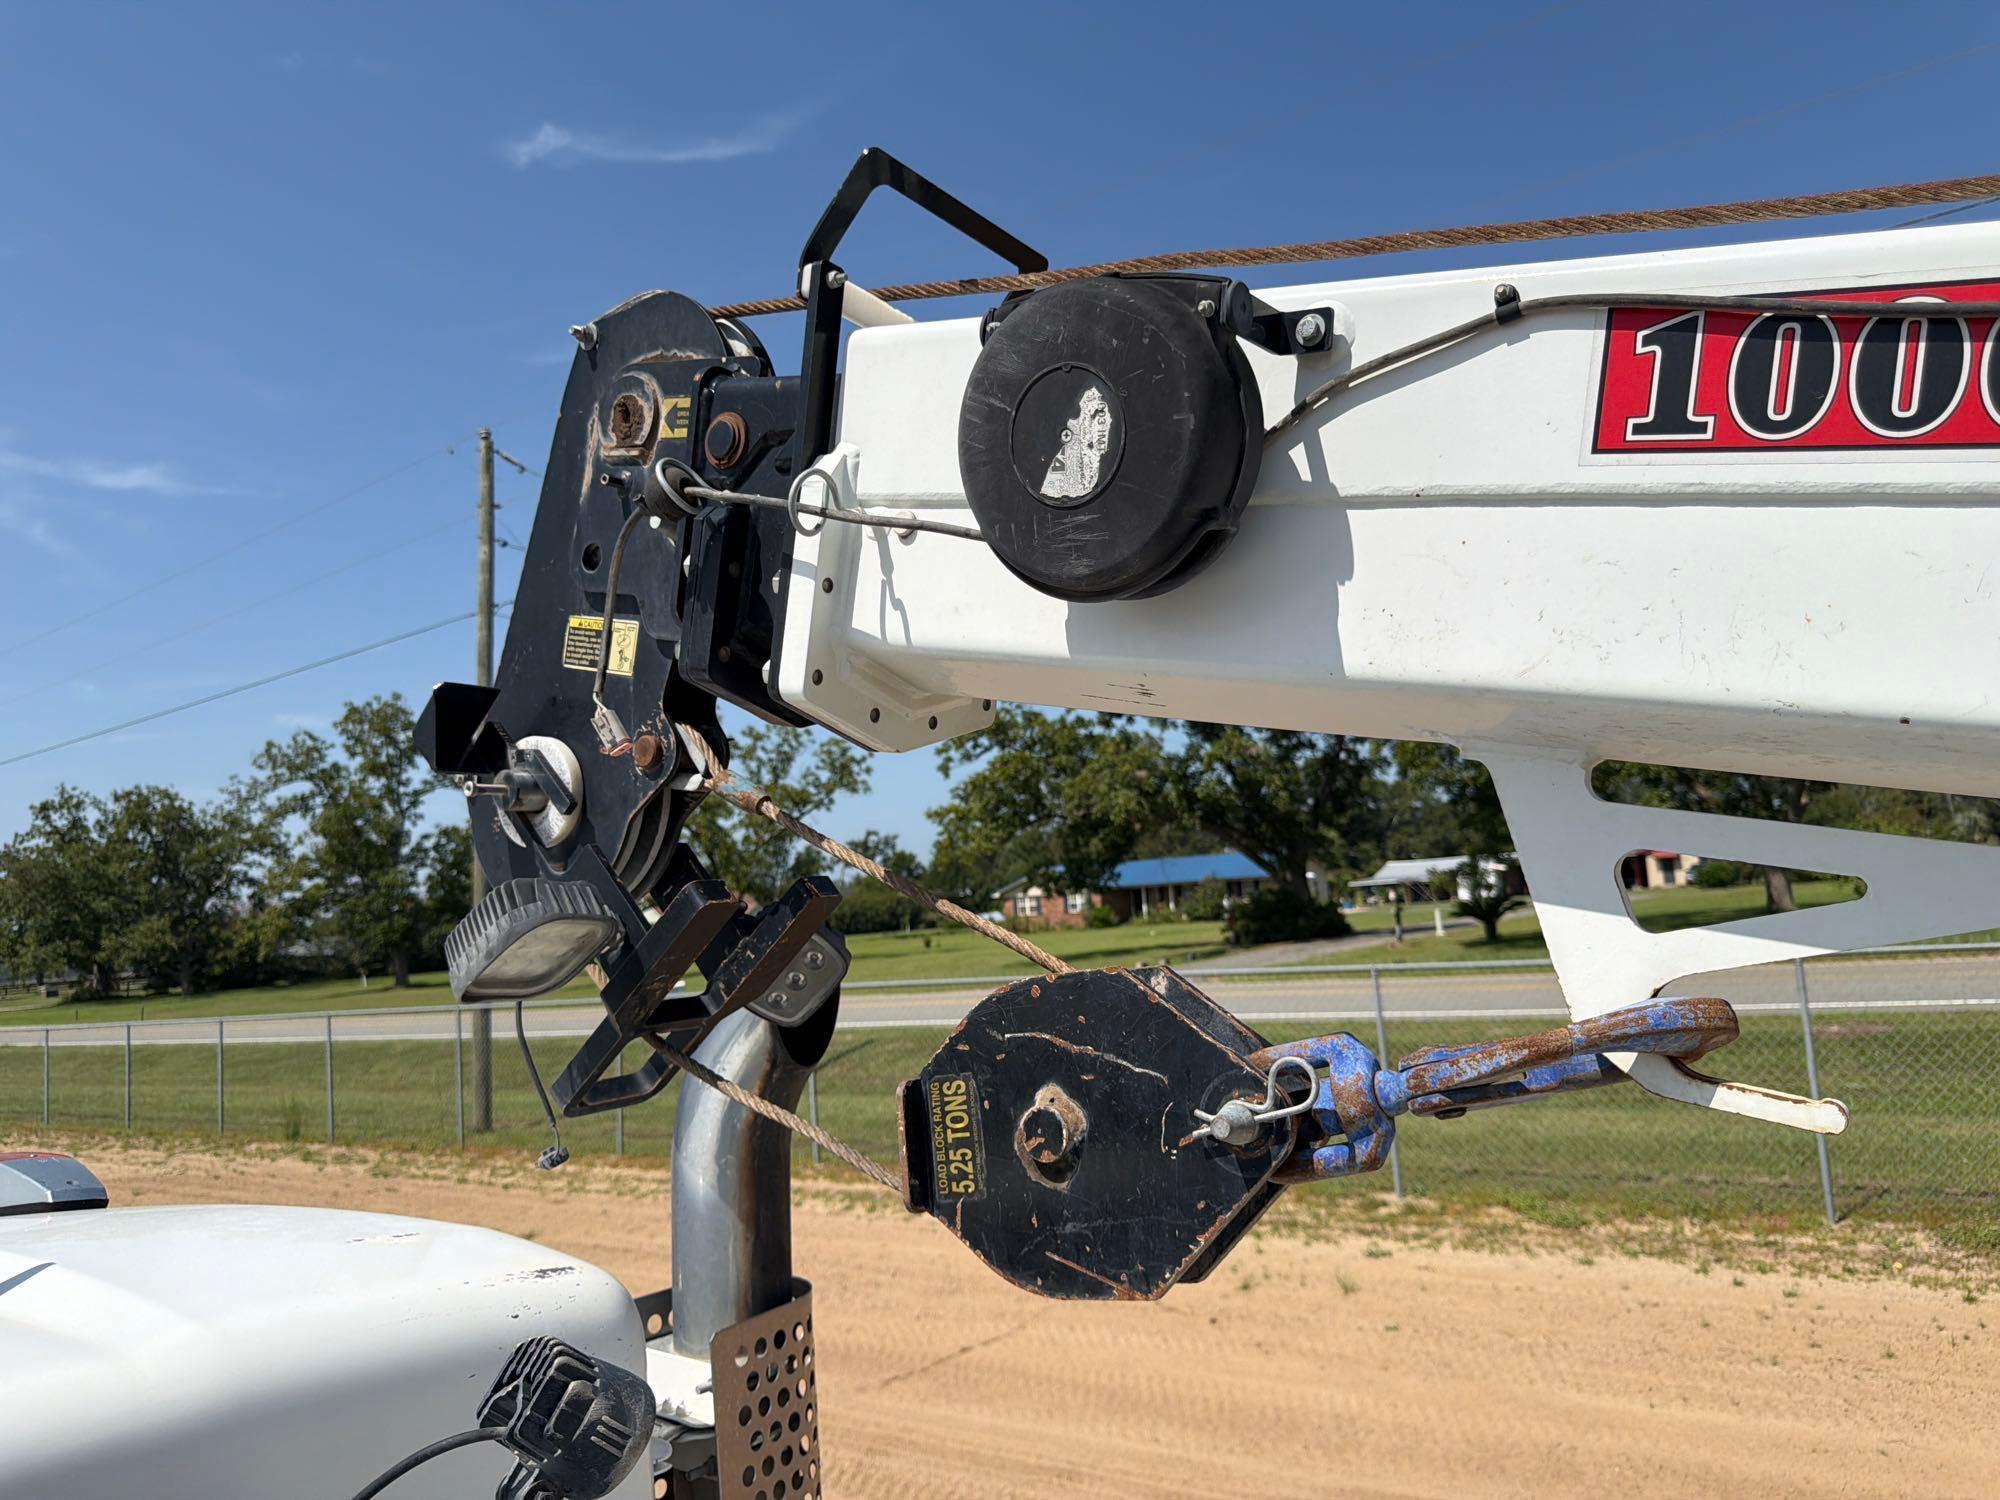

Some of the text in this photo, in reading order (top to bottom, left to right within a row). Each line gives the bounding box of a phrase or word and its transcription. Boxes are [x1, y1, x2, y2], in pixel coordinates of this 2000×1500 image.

[1625, 295, 2000, 440] 100
[931, 1082, 948, 1194] LOAD BLOCK RATING
[943, 1080, 975, 1194] 5.25 TONS
